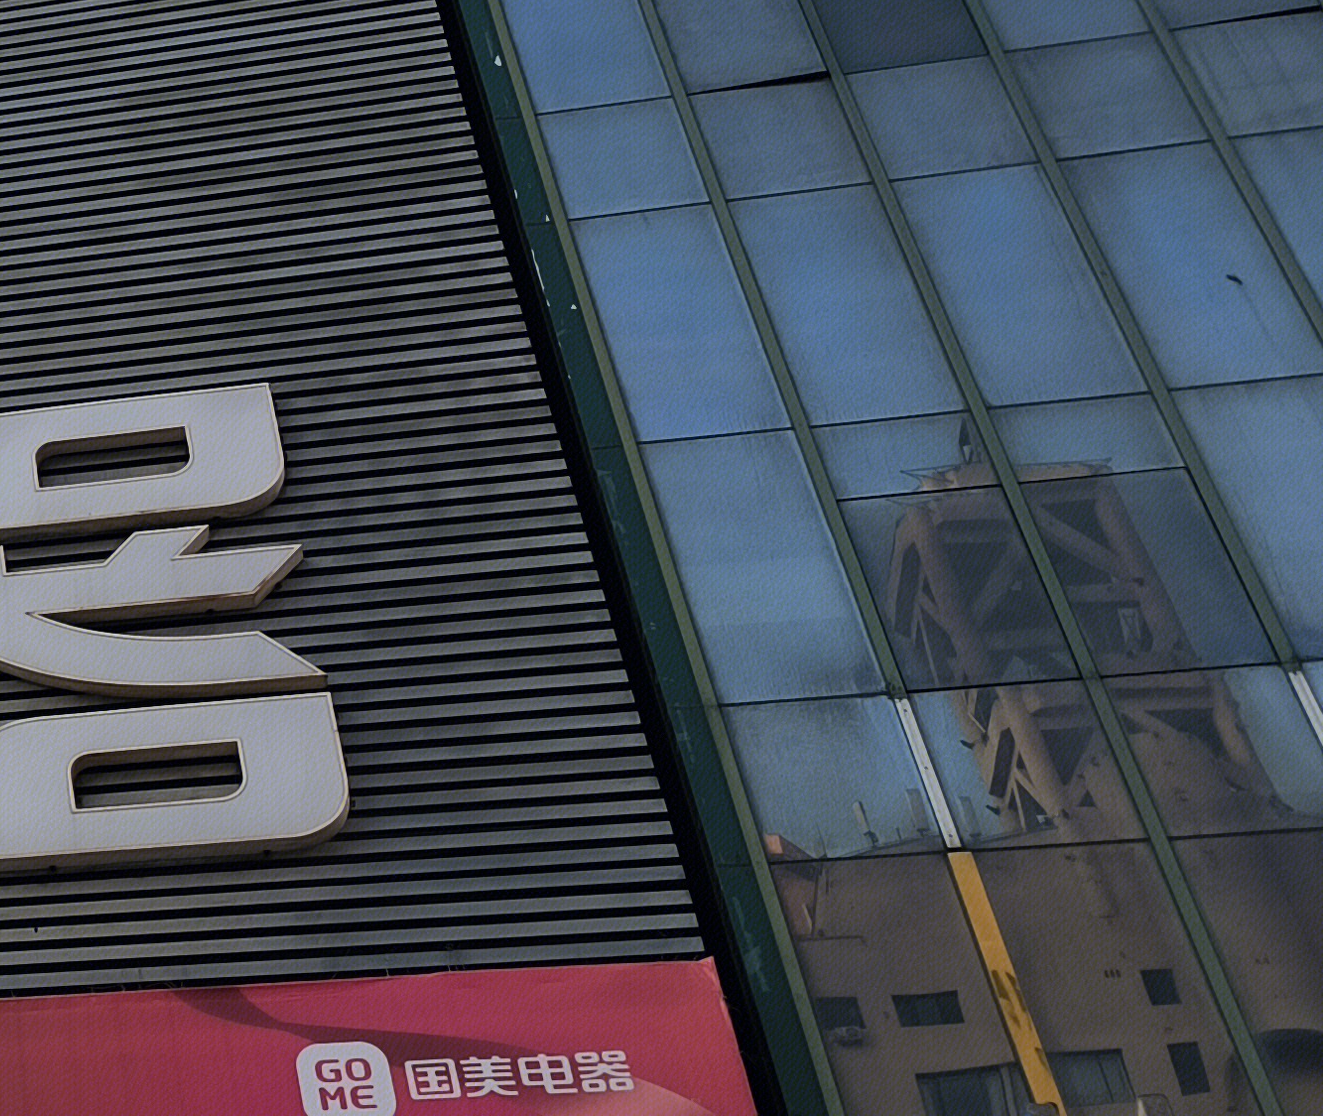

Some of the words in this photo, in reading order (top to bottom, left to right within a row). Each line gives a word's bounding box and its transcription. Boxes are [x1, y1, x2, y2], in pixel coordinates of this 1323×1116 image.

[313, 1056, 374, 1085] GO
[404, 1049, 636, 1102] 国美电器
[318, 1086, 379, 1112] ME
